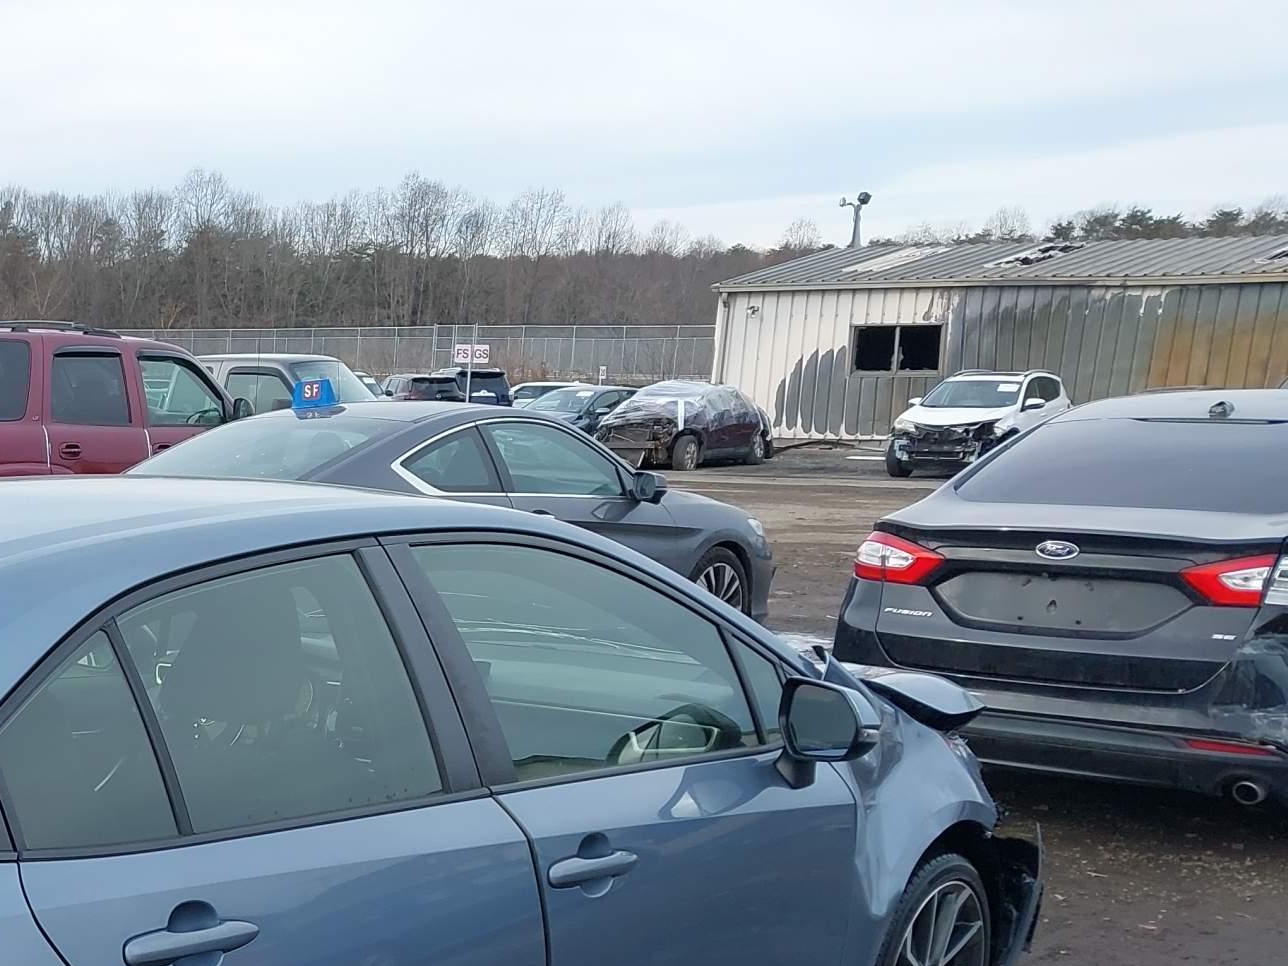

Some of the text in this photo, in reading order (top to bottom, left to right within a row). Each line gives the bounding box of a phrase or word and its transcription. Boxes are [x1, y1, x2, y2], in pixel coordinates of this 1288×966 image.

[456, 348, 469, 359] FS
[474, 348, 489, 359] GS
[304, 384, 319, 398] SF
